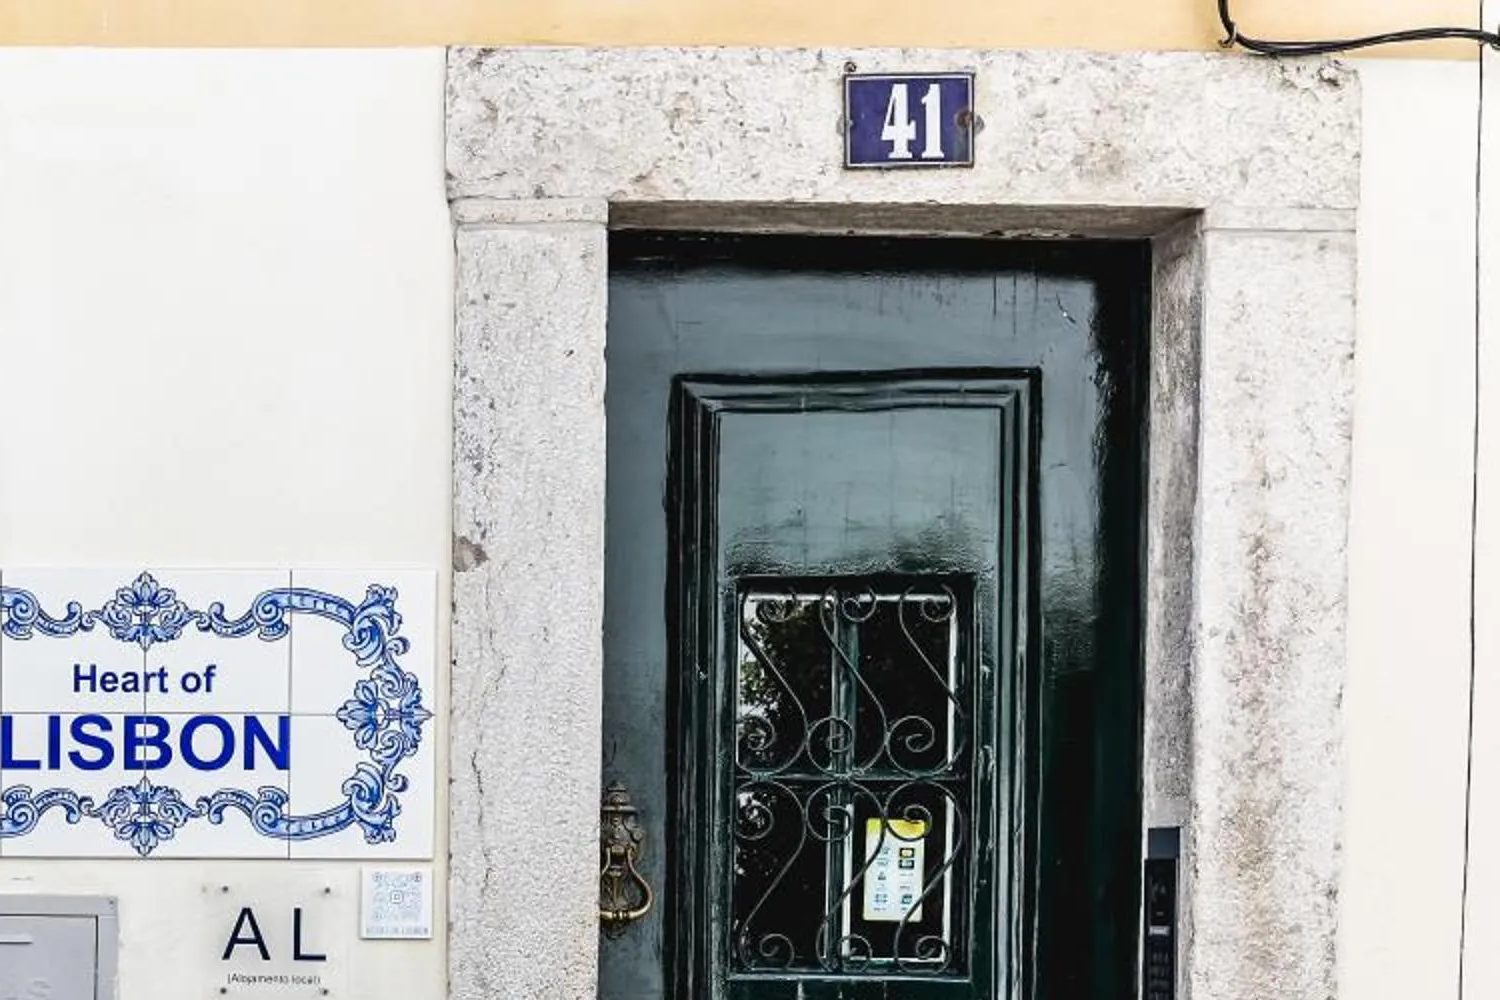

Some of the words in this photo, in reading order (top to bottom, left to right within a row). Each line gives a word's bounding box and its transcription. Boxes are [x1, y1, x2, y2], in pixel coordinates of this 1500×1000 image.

[881, 83, 945, 159] 41
[72, 663, 169, 694] Heart
[180, 664, 217, 694] of
[0, 713, 291, 771] LISBON
